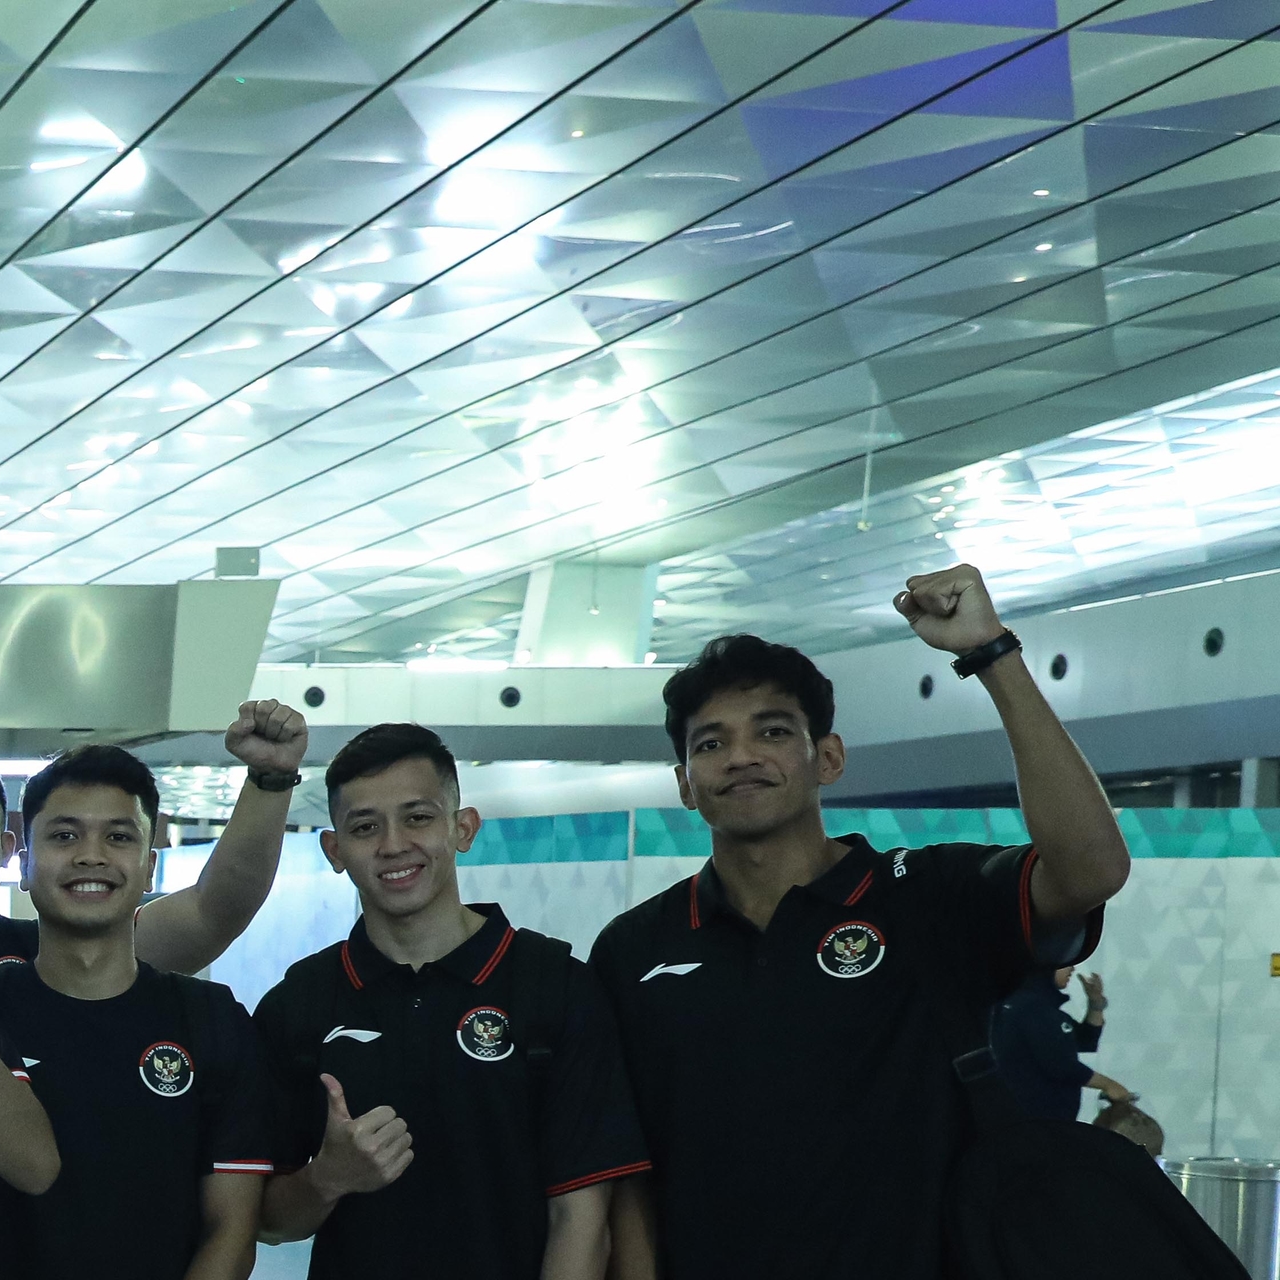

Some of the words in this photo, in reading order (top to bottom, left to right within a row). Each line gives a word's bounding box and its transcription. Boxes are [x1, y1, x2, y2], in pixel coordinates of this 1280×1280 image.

[823, 933, 836, 947] TIM
[463, 1013, 477, 1025] TIM
[144, 1049, 156, 1062] TIM
